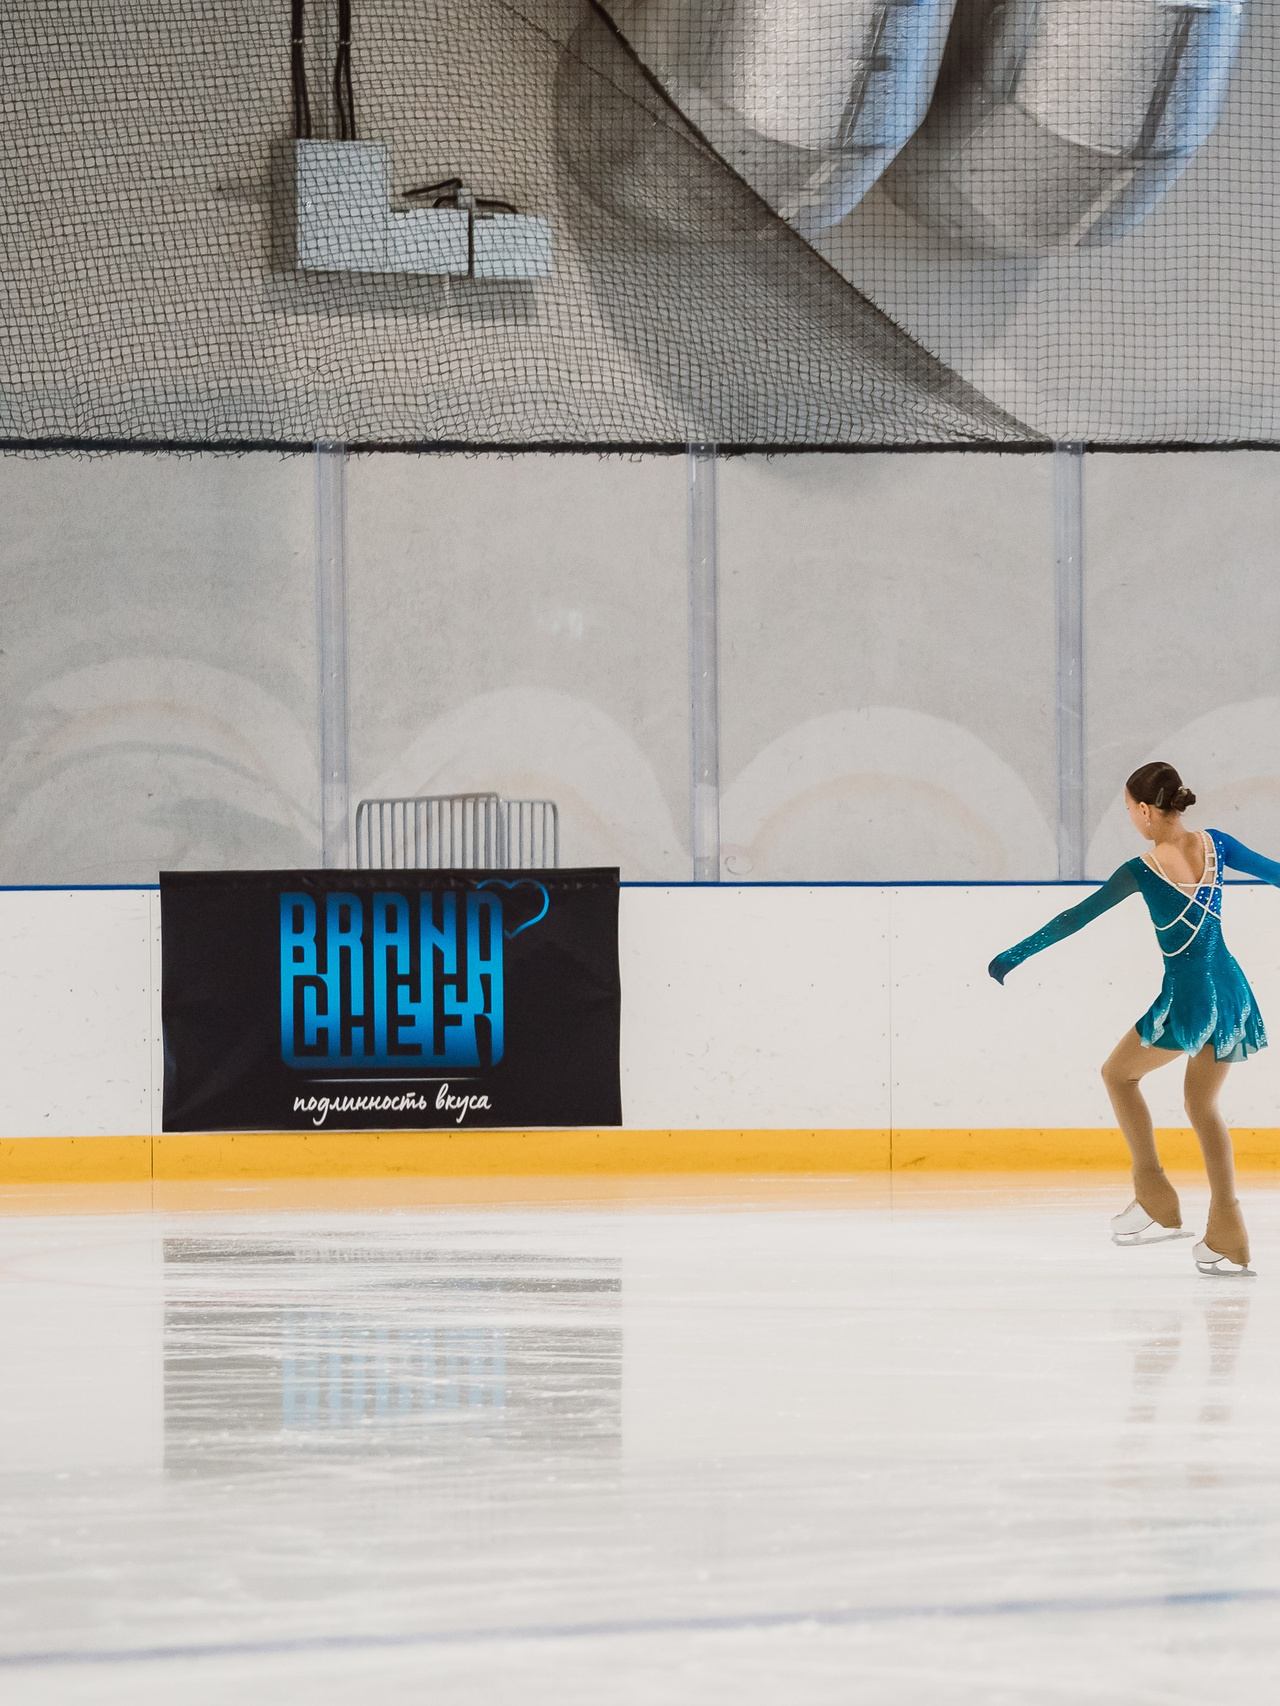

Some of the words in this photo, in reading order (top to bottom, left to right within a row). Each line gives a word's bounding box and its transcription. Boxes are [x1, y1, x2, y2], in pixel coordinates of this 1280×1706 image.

[280, 891, 503, 976] BRAND
[293, 1091, 428, 1126] подлинность
[435, 1083, 492, 1124] вкуса
